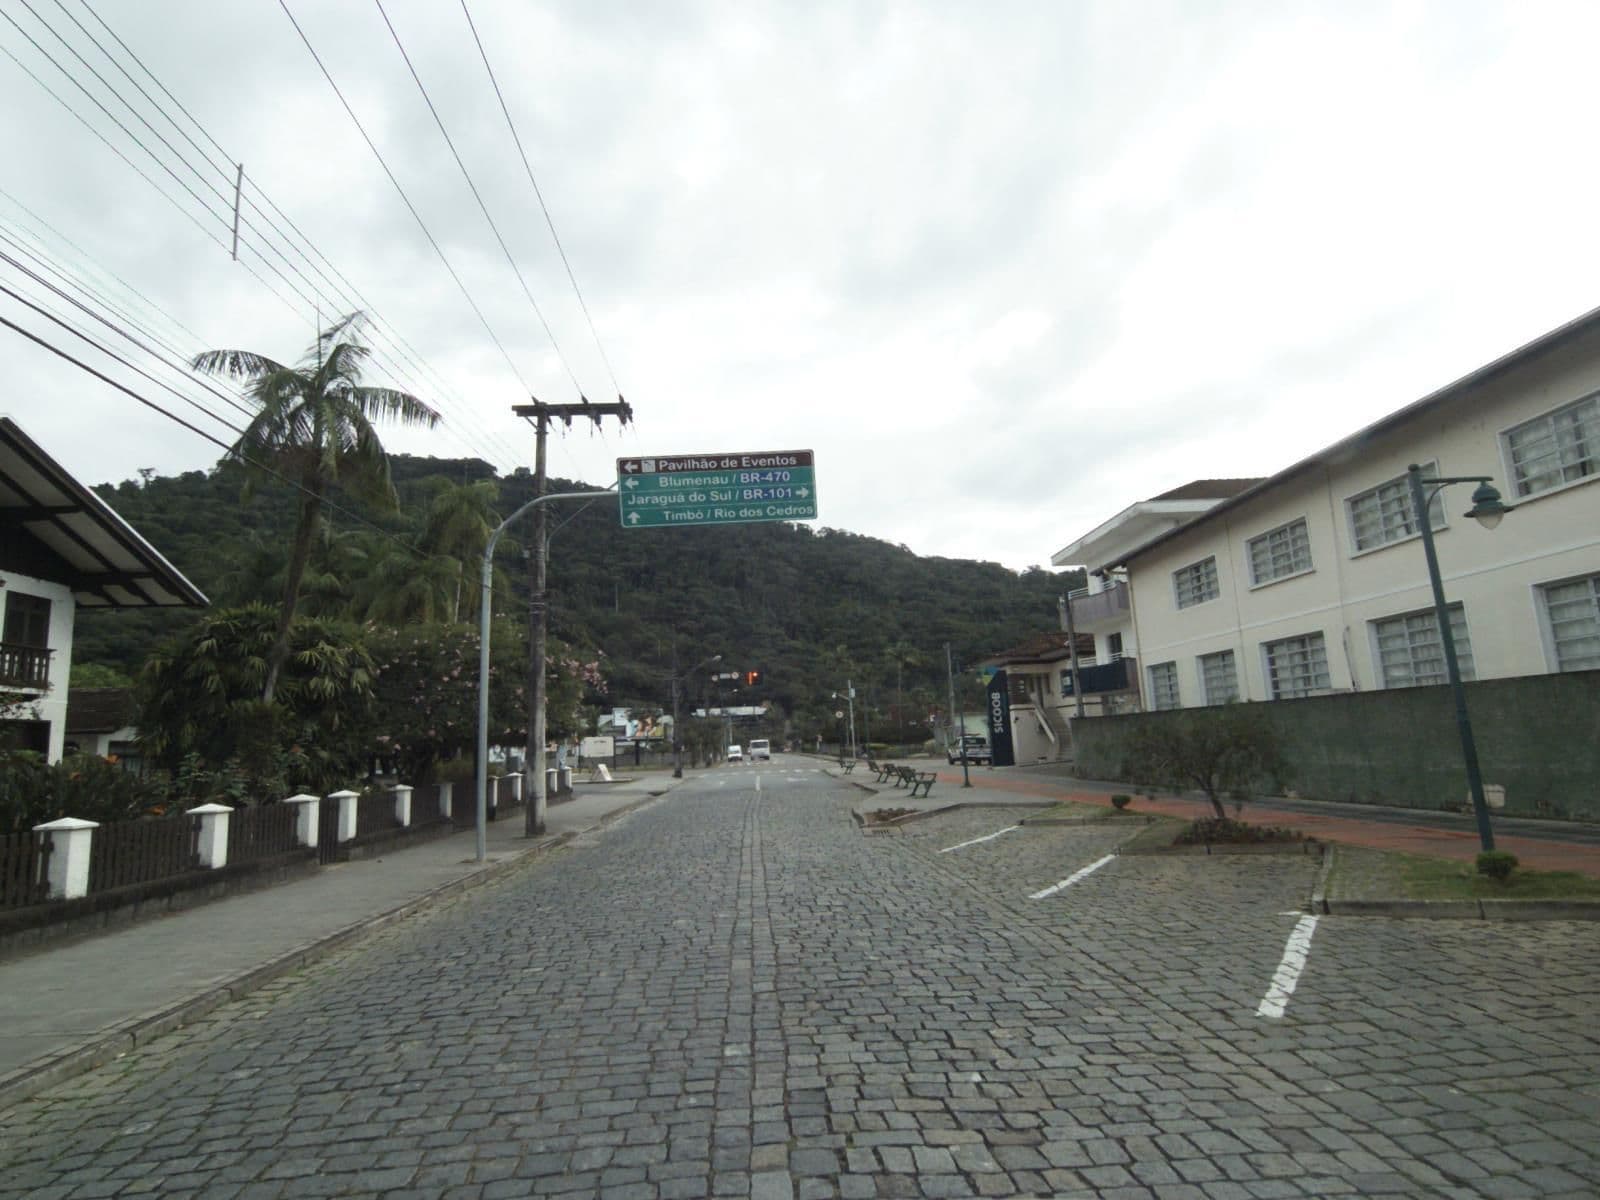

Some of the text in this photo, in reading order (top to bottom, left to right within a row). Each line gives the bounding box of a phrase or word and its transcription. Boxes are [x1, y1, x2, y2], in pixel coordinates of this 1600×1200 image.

[659, 456, 796, 471] Pavilhão de Eventos
[659, 476, 728, 487] Blumenau
[740, 472, 790, 483] BR-470
[689, 491, 706, 502] do
[710, 490, 731, 501] Sul
[743, 488, 791, 499] BR-101
[715, 507, 735, 519] Rio
[740, 506, 763, 518] dos
[766, 503, 813, 516] Cedros
[991, 692, 1004, 733] SICOOB
